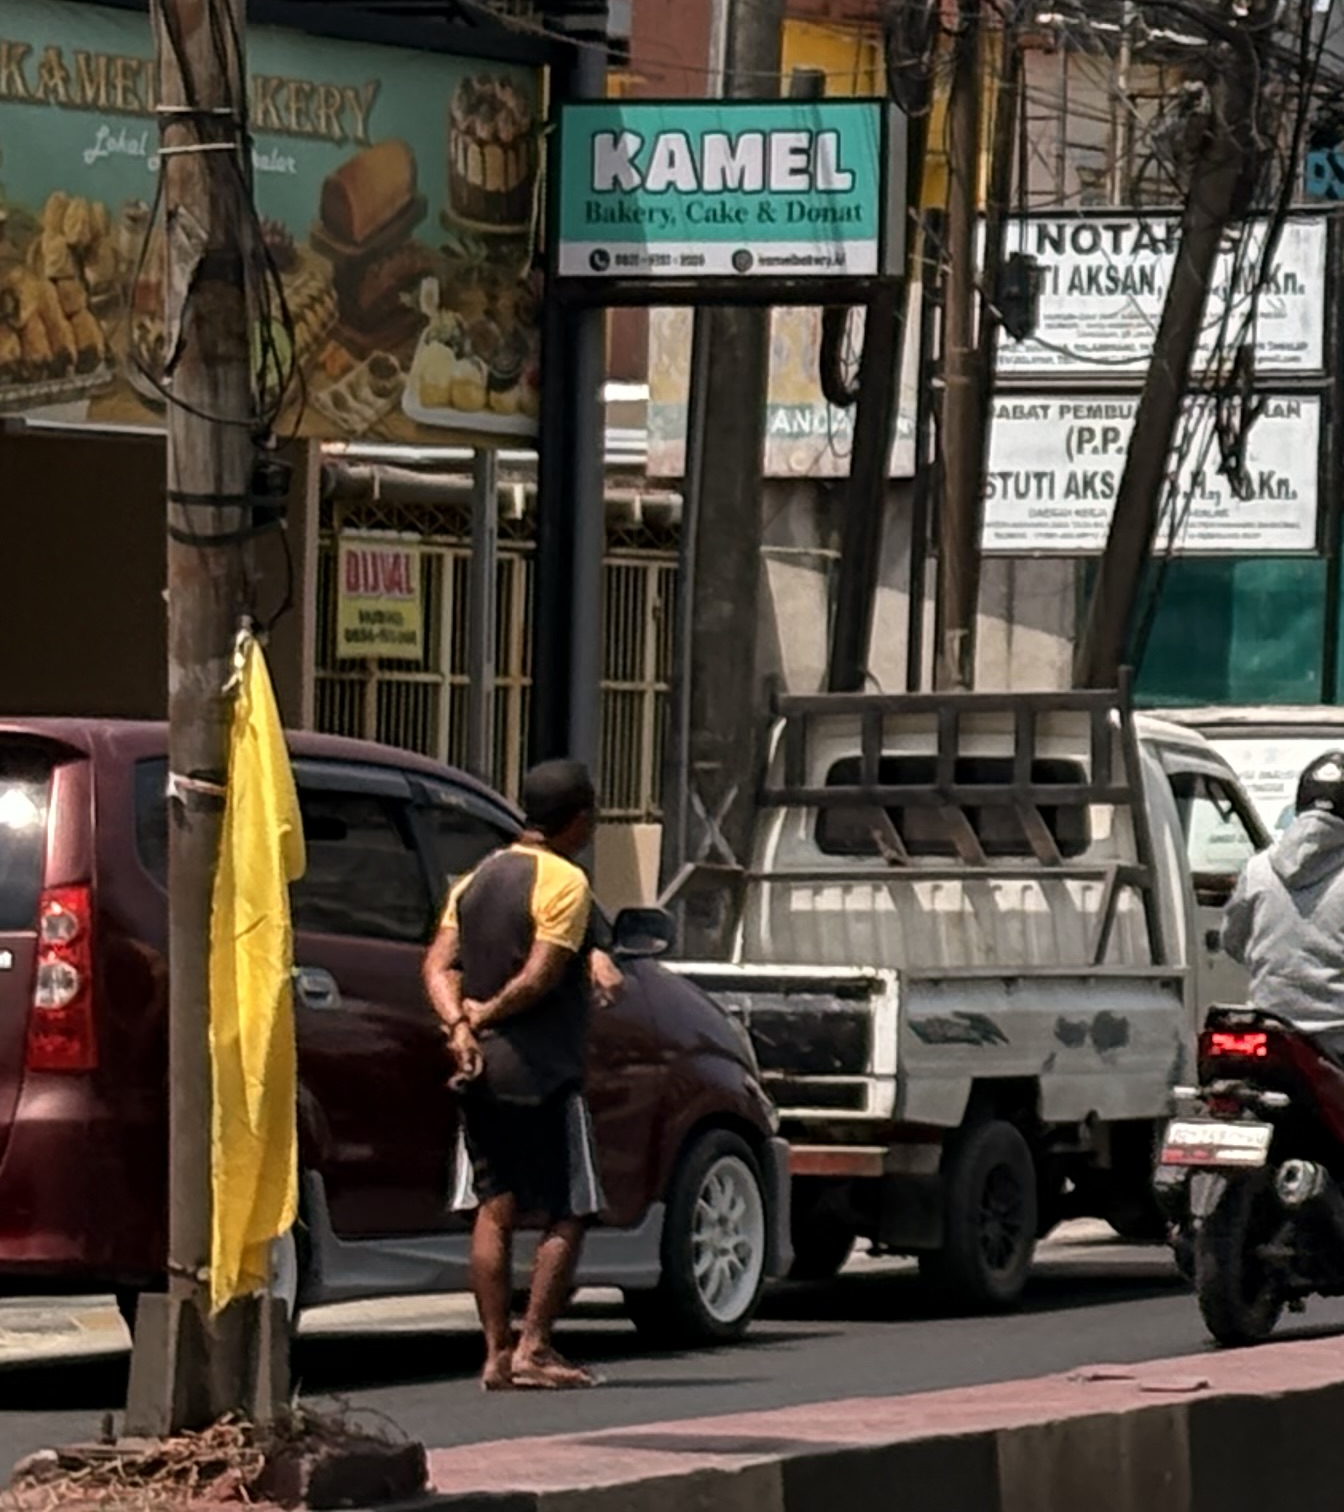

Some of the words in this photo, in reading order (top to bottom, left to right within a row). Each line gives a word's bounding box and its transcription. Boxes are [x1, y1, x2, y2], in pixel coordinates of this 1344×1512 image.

[252, 73, 381, 143] KERY
[592, 130, 854, 192] KAMEL
[585, 199, 677, 229] Bakery,
[685, 200, 749, 225] Cake
[756, 200, 777, 224] &
[786, 199, 863, 224] Donat
[984, 469, 1056, 501] STUTI
